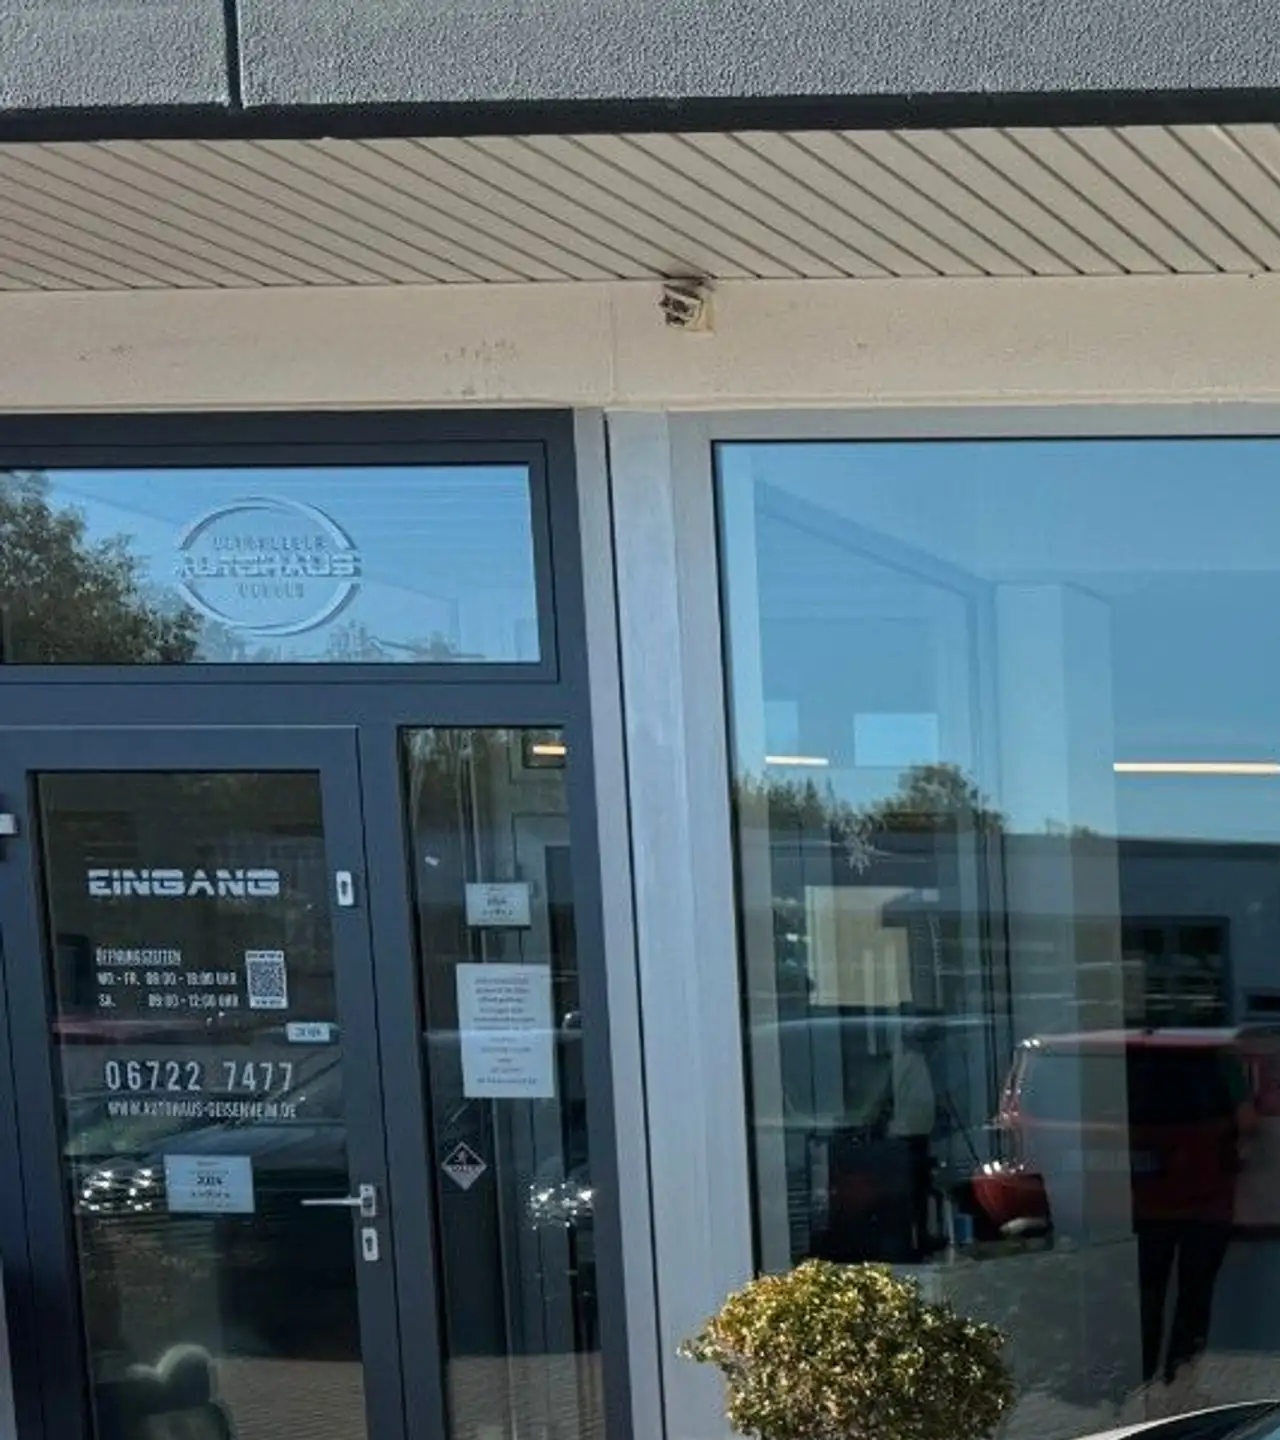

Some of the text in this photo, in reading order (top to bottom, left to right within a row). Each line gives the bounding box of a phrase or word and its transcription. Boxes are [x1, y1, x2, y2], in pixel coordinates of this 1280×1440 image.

[88, 869, 280, 897] EINGANG
[105, 1060, 293, 1093] 06722 7477
